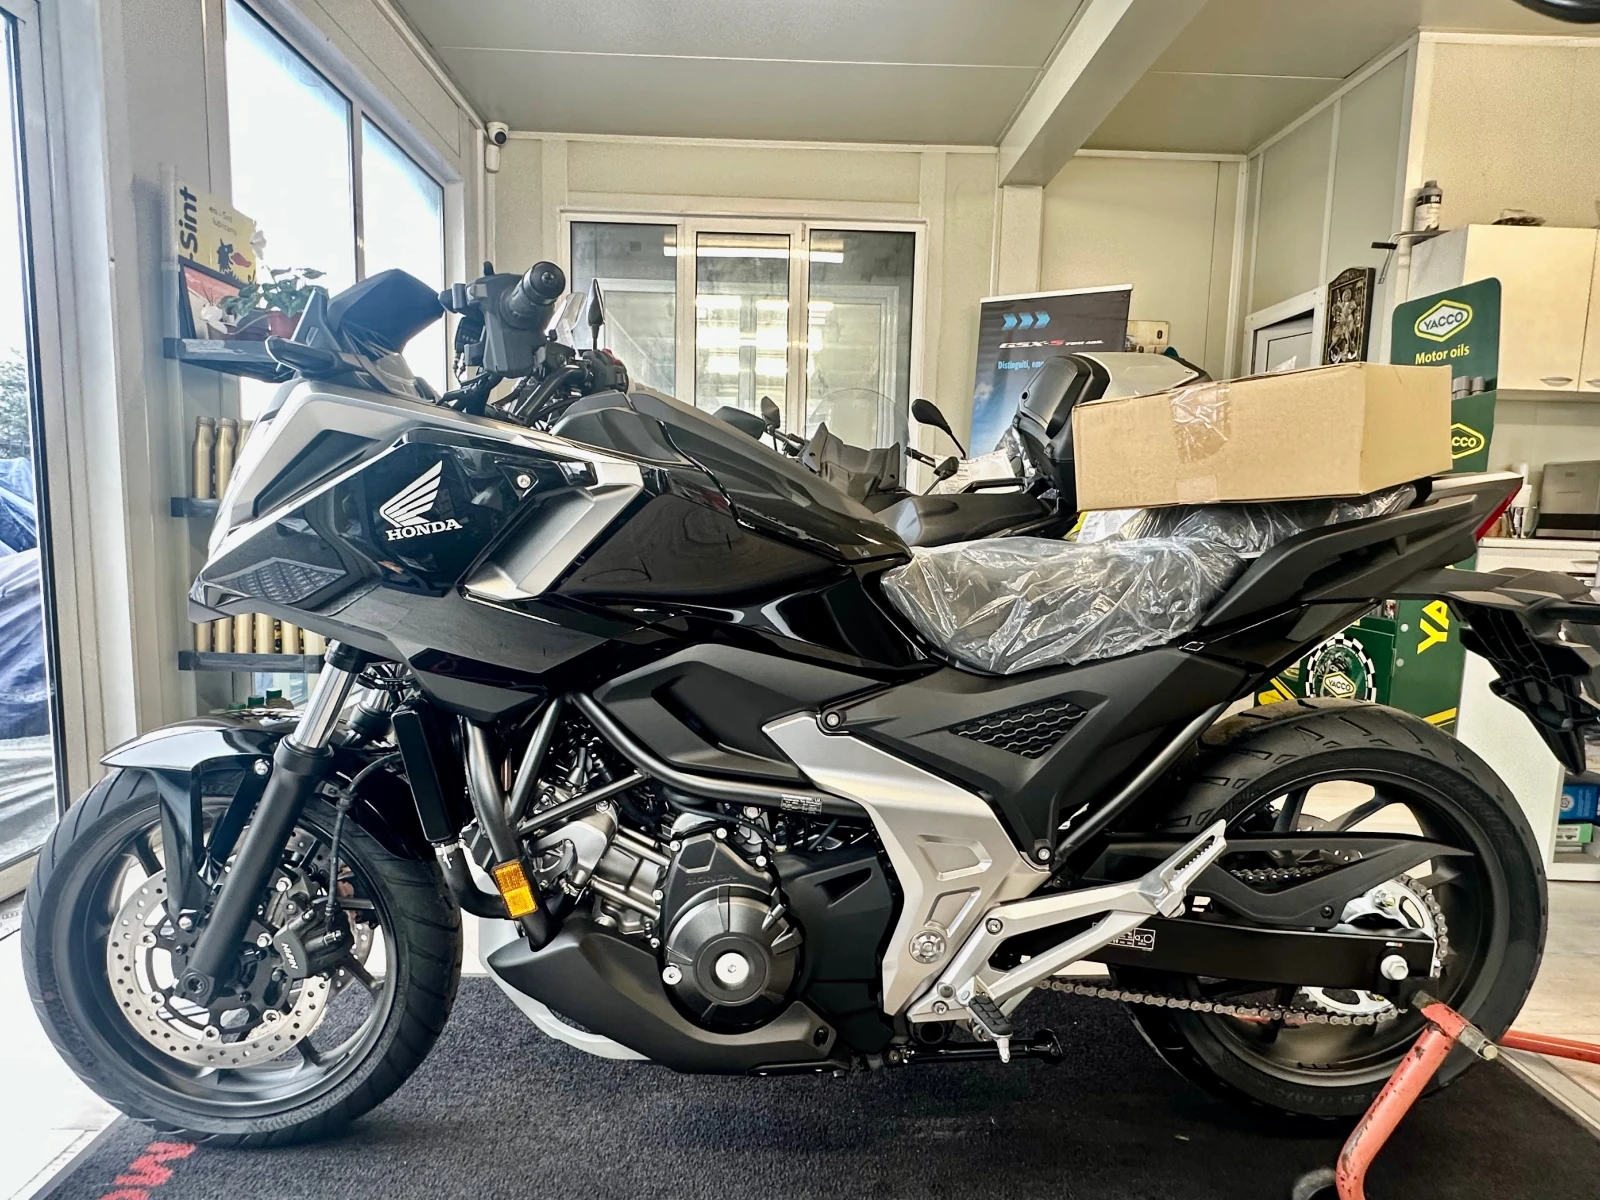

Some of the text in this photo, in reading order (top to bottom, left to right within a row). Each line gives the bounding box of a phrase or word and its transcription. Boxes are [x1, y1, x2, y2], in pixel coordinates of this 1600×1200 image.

[1423, 311, 1464, 331] YACCO
[1415, 343, 1470, 365] Motor oils
[385, 518, 463, 541] HONDA
[1328, 679, 1351, 692] YACCO
